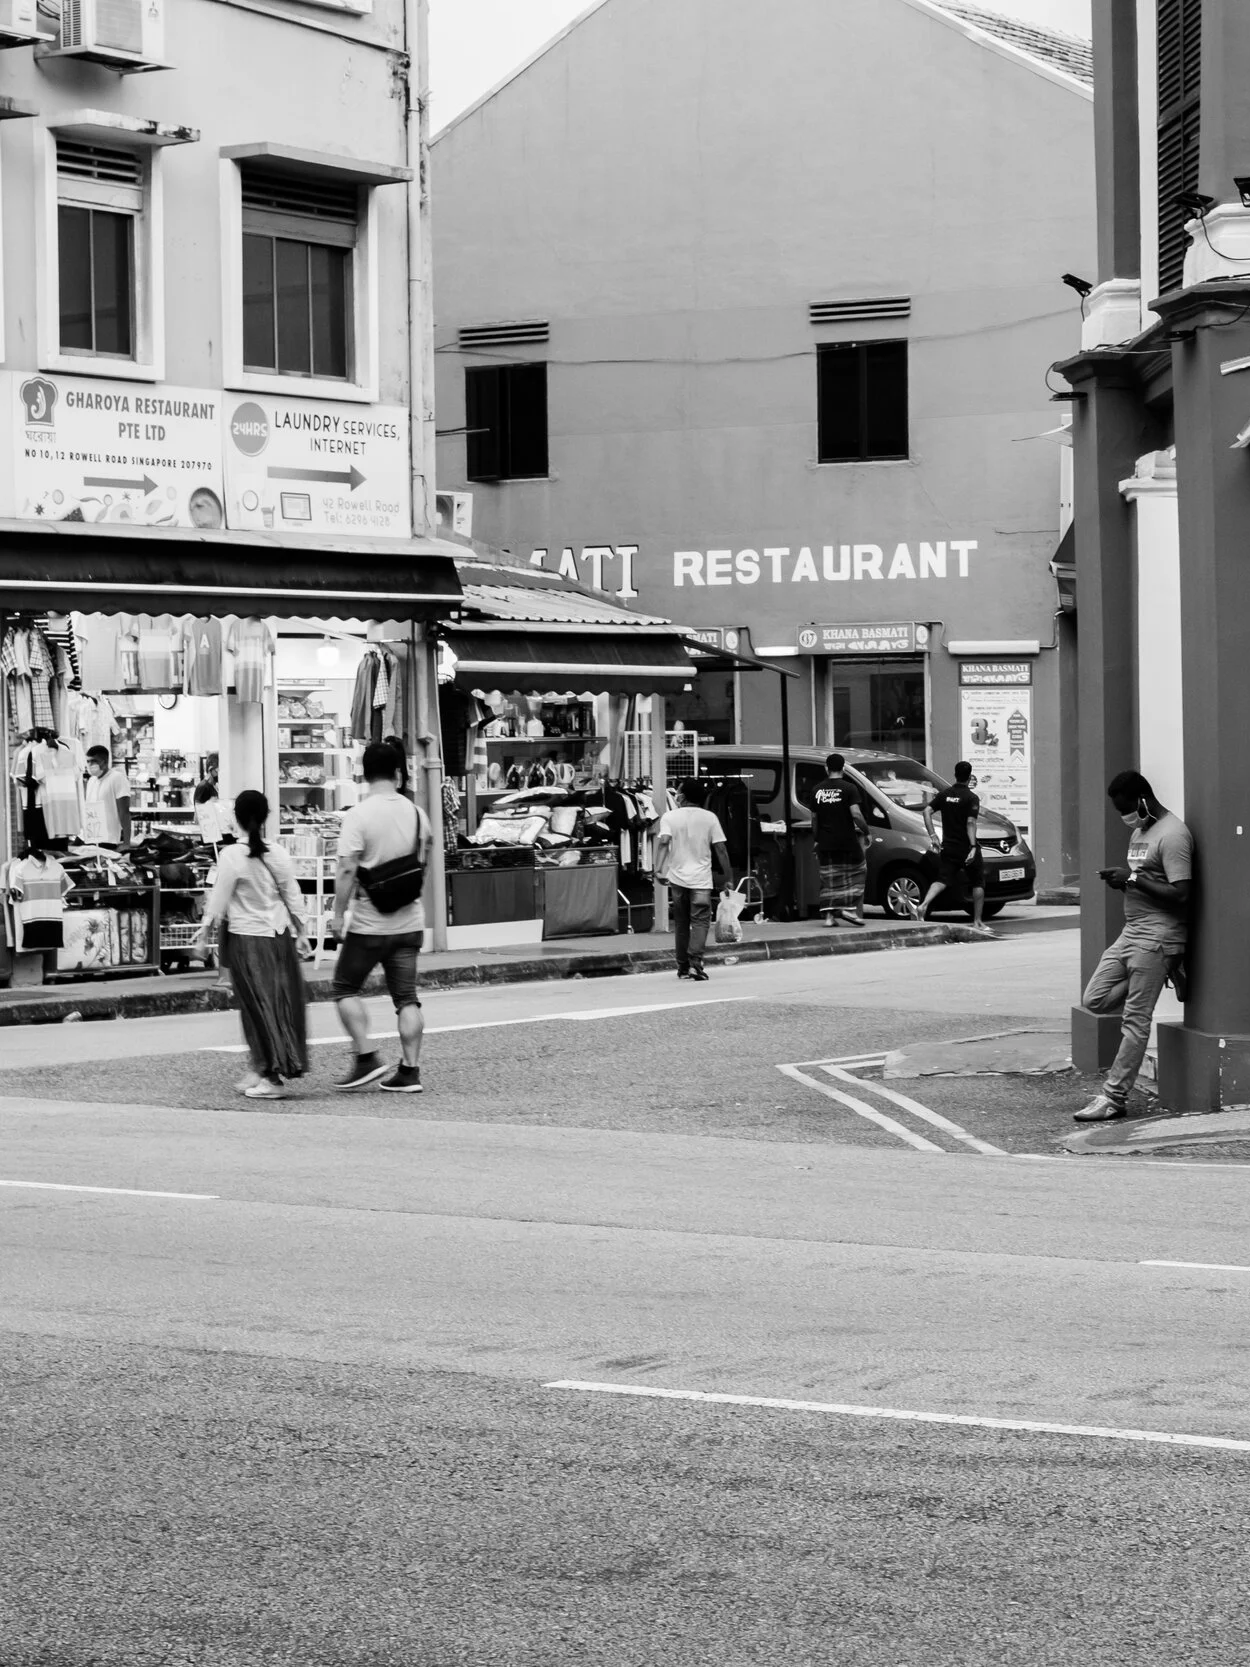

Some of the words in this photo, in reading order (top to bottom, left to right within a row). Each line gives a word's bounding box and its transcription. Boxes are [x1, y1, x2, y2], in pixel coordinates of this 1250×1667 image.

[66, 391, 130, 412] GHAROYA
[135, 398, 215, 420] RESTAURANT
[232, 421, 268, 438] 24HRS
[275, 411, 341, 433] LAUNDRY
[118, 422, 140, 439] PTE
[145, 425, 166, 441] LTD
[310, 438, 367, 456] INTERNET
[25, 449, 37, 458] NO
[69, 452, 102, 463] ROWELL
[105, 454, 128, 465] ROAD
[131, 457, 177, 468] SINGAPORE
[181, 460, 212, 471] 207970
[337, 497, 372, 512] Rowell
[529, 545, 639, 598] ATI
[673, 540, 978, 587] RESTAURANT
[822, 629, 859, 640] KHANA
[861, 627, 908, 639] BASMATI
[961, 664, 991, 673] KHANA
[992, 664, 1029, 673] BASMATI
